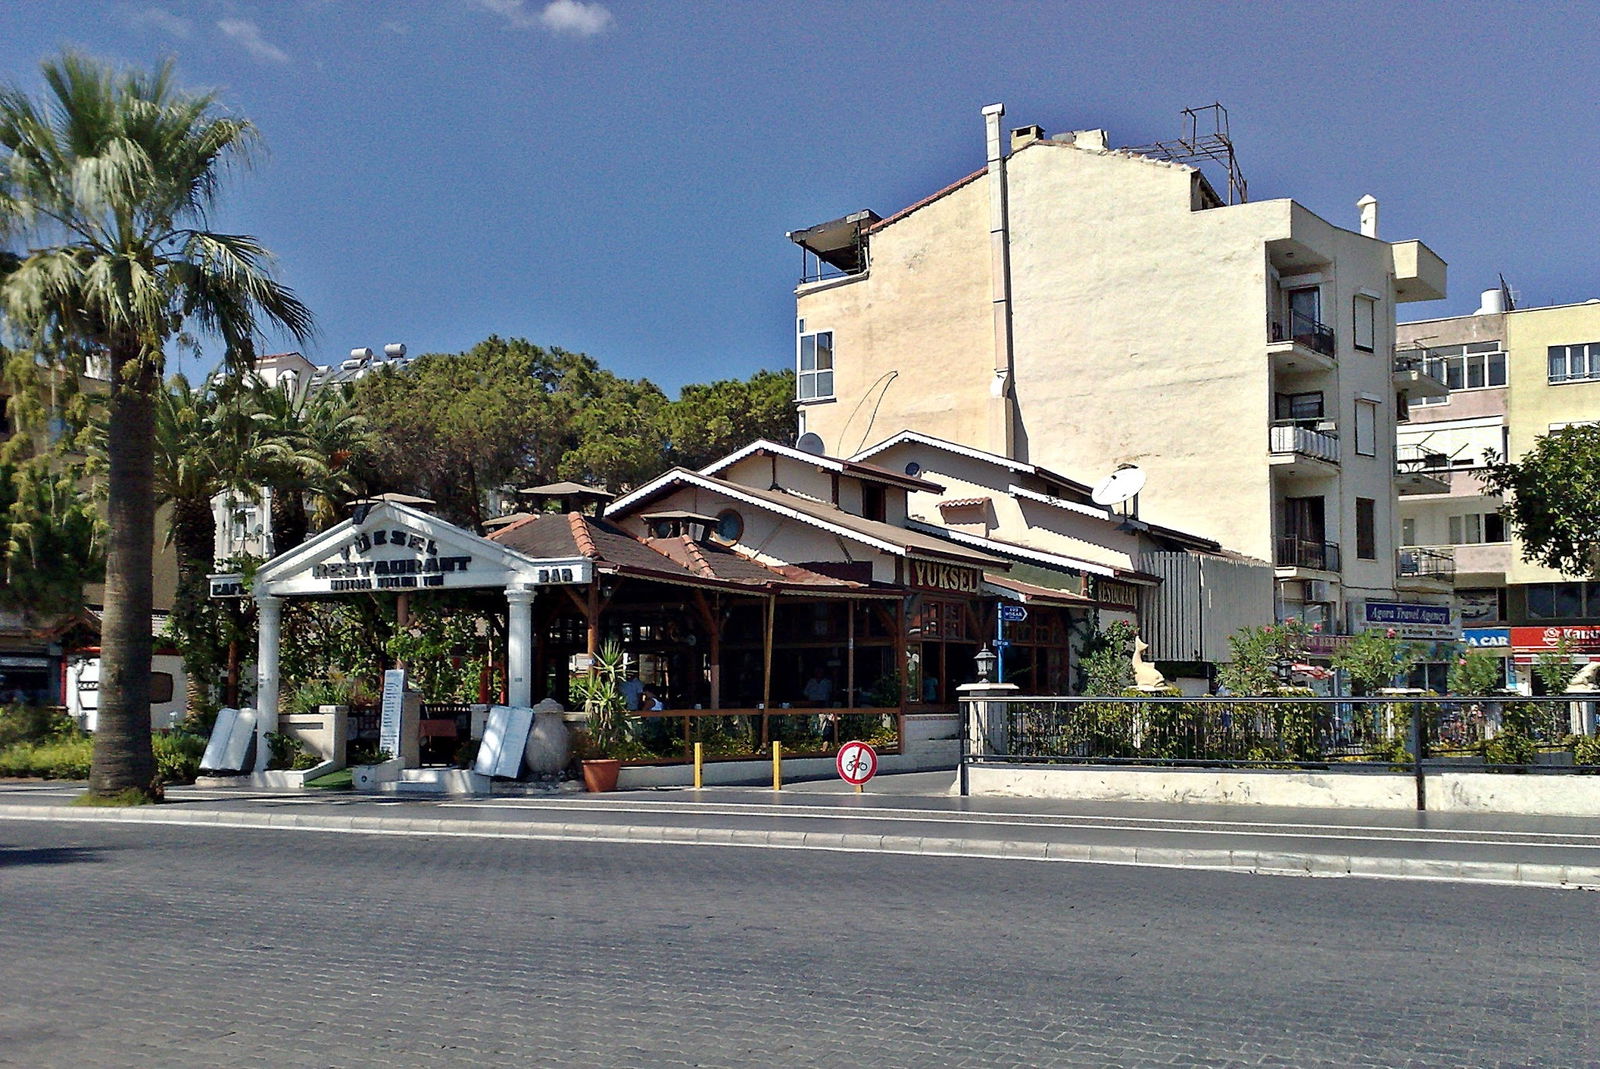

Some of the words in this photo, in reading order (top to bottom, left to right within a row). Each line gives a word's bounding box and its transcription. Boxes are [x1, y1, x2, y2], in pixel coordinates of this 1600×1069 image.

[313, 556, 472, 578] RESTAURANT
[539, 568, 573, 582] BAR
[1371, 607, 1394, 621] Agora
[1396, 608, 1419, 620] Travel
[1420, 610, 1447, 625] Agency
[1468, 637, 1479, 646] A
[1480, 636, 1509, 646] CAR
